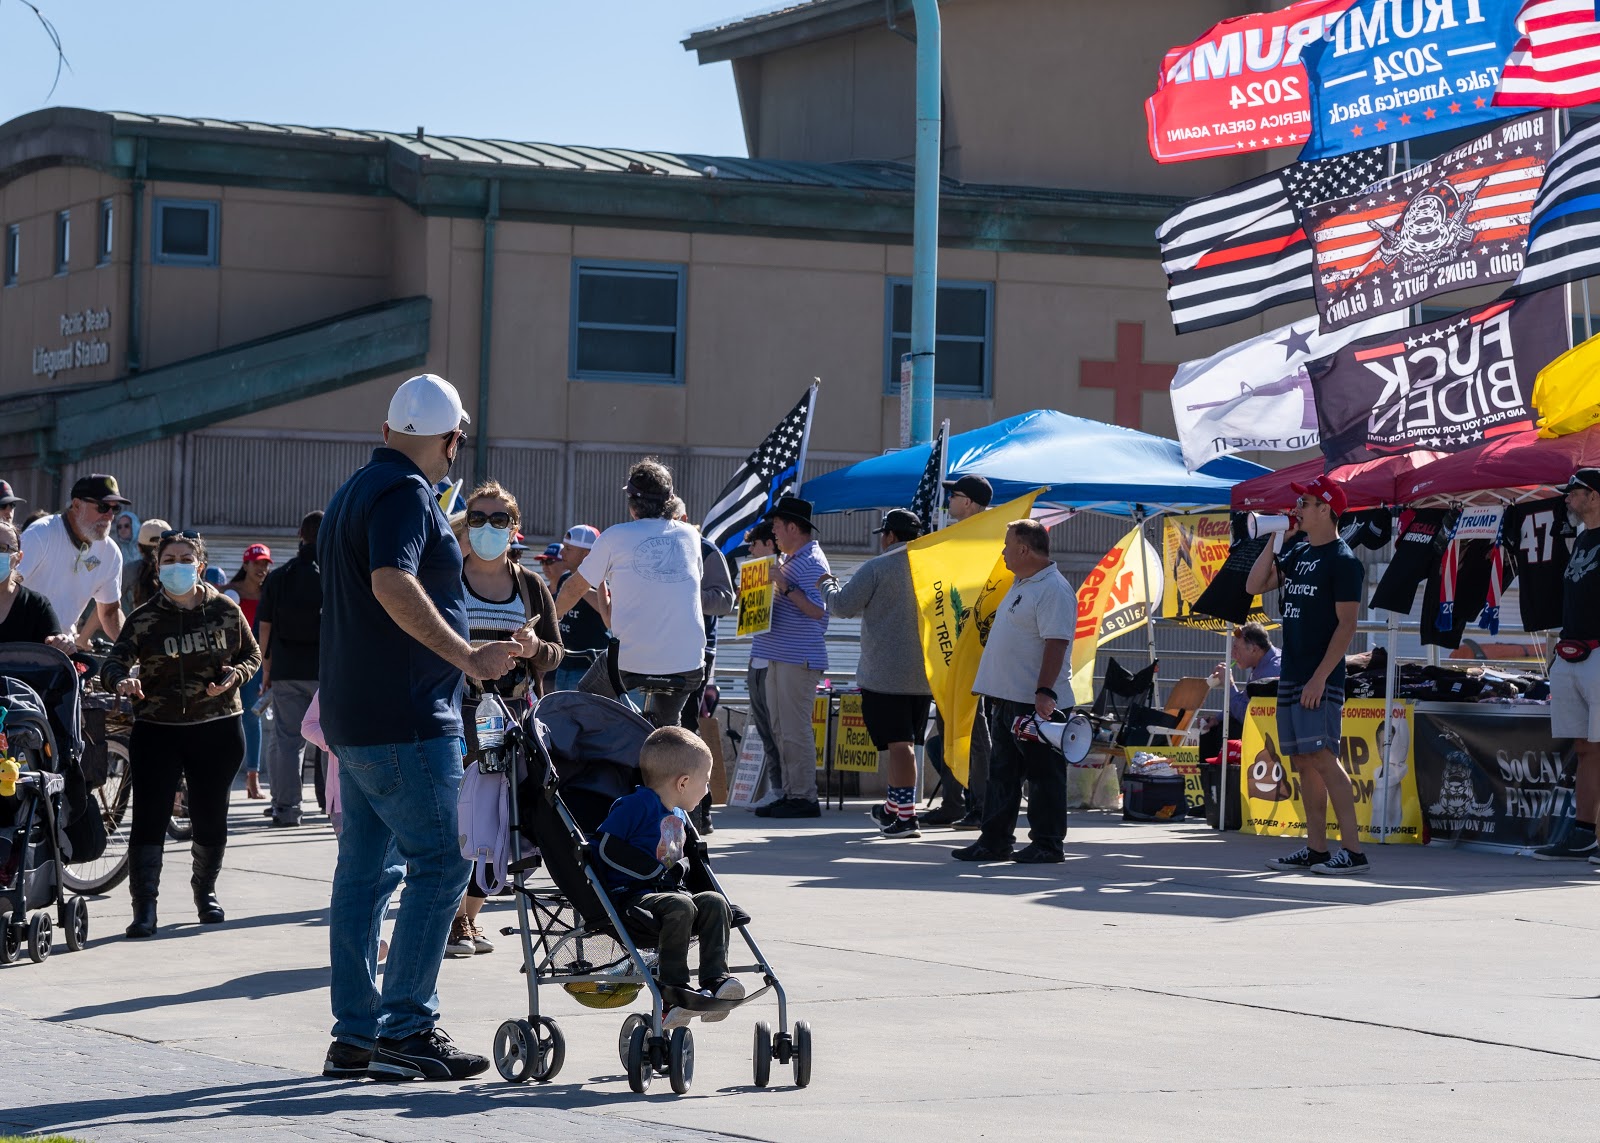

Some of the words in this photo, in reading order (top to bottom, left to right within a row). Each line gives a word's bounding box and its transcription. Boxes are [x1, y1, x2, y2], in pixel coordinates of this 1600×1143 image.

[60, 313, 84, 336] Pacific
[85, 306, 110, 332] Beach
[32, 341, 74, 379] Lifeguard
[75, 338, 109, 368] Station
[1409, 522, 1437, 534] RECALL
[1461, 514, 1497, 528] TRUMP
[1402, 532, 1432, 544] NEWSOM
[1519, 510, 1554, 563] 47
[1295, 559, 1320, 576] 1776
[747, 589, 765, 608] GAVIN
[933, 581, 945, 617] DONT
[745, 607, 771, 626] NEWSOM
[1250, 706, 1266, 717] SIGN
[1266, 706, 1276, 717] UP
[1392, 708, 1407, 719] OW!
[846, 728, 870, 746] Recall
[836, 743, 877, 767] Newsom
[1254, 817, 1278, 827] PAPER
[1390, 826, 1417, 835] MORE!
[1465, 819, 1480, 831] ON
[1482, 821, 1496, 833] ME
